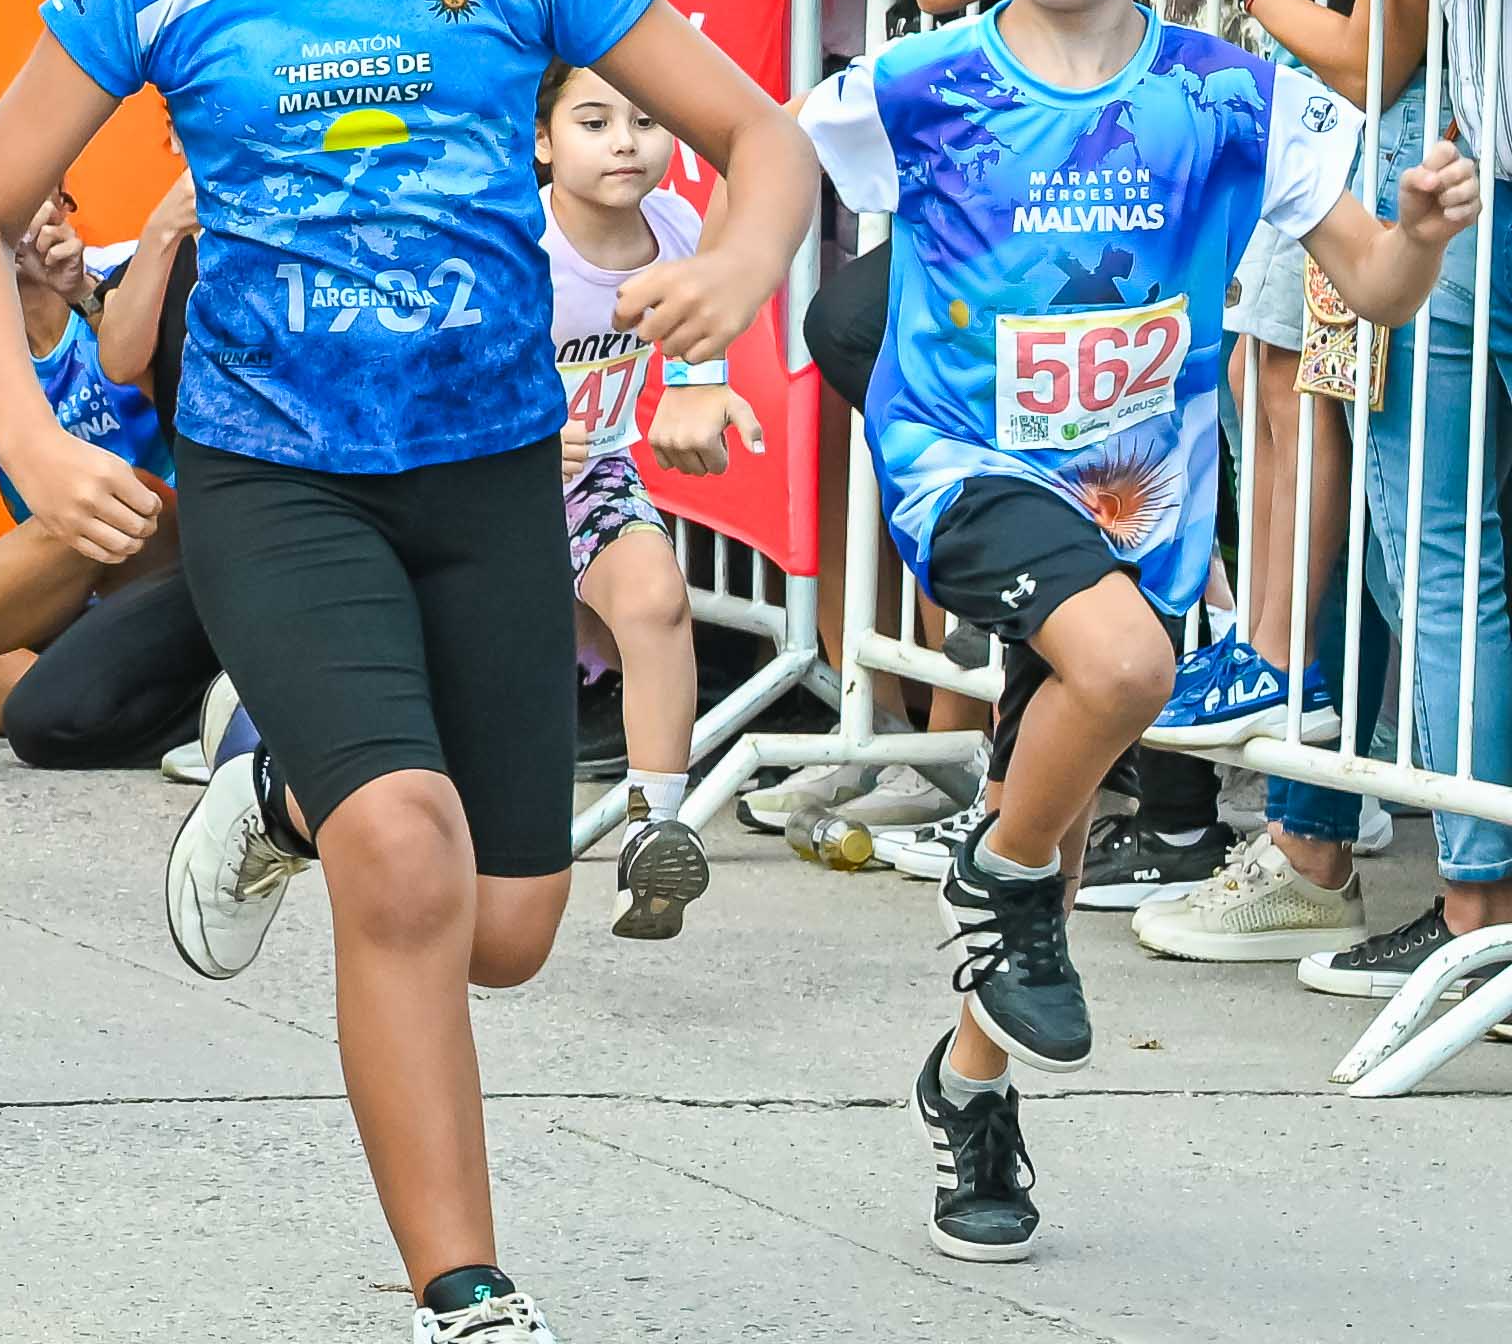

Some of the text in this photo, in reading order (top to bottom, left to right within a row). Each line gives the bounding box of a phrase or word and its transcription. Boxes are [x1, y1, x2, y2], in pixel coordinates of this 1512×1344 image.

[301, 33, 401, 58] MARATÓN
[396, 52, 432, 74] DE
[1029, 166, 1151, 186] MARATÓN
[1029, 186, 1150, 202] HÉROES DE
[1012, 203, 1165, 233] MALVINAS
[312, 286, 439, 307] ARGENTINA
[1016, 315, 1181, 414] 562
[1204, 670, 1280, 713] FILA
[1133, 867, 1161, 881] FILA
